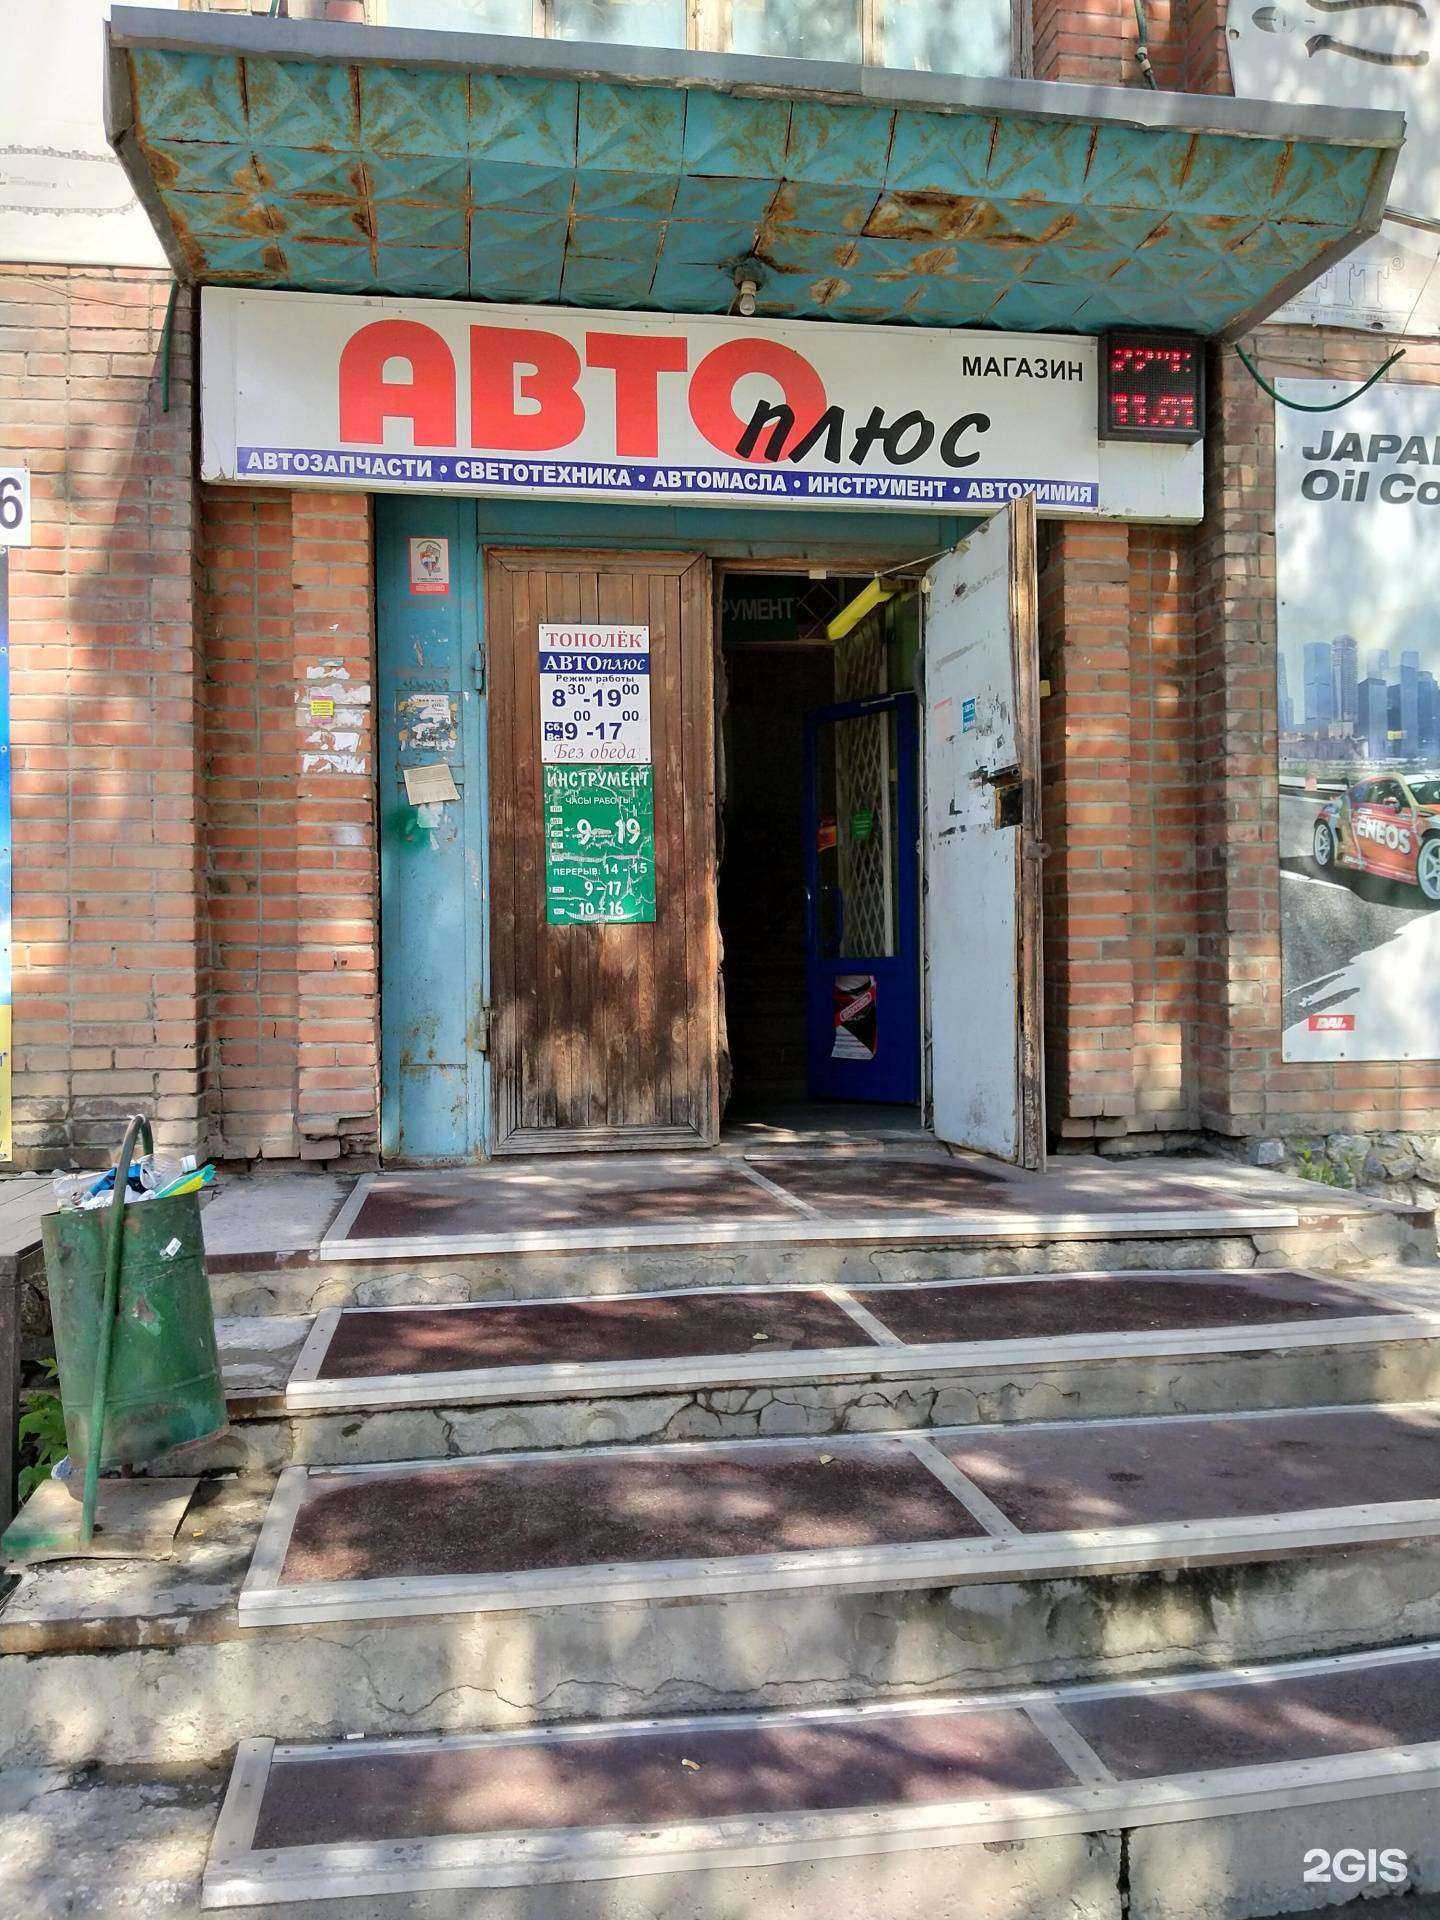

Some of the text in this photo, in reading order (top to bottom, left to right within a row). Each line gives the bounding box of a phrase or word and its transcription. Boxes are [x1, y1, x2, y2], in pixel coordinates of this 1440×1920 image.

[962, 356, 1084, 381] МАГАЗИН
[339, 319, 827, 464] АВТО
[246, 451, 433, 478] АВТОЗАПЧАСТИ
[455, 461, 632, 486] СВЕТОТЕХНИКА
[653, 469, 787, 493] АВТОМАСЛА
[807, 475, 947, 498] ИНСТРУМЕНТ
[1301, 469, 1369, 502] Oil
[546, 631, 642, 648] ТОПОЛЁК
[556, 675, 635, 684] Режим работы
[554, 742, 636, 759] Без обеда
[547, 771, 649, 787] ИНСТРУМЕНТ
[565, 797, 592, 805] ЧАСЫ
[1356, 815, 1411, 854] ENEOS
